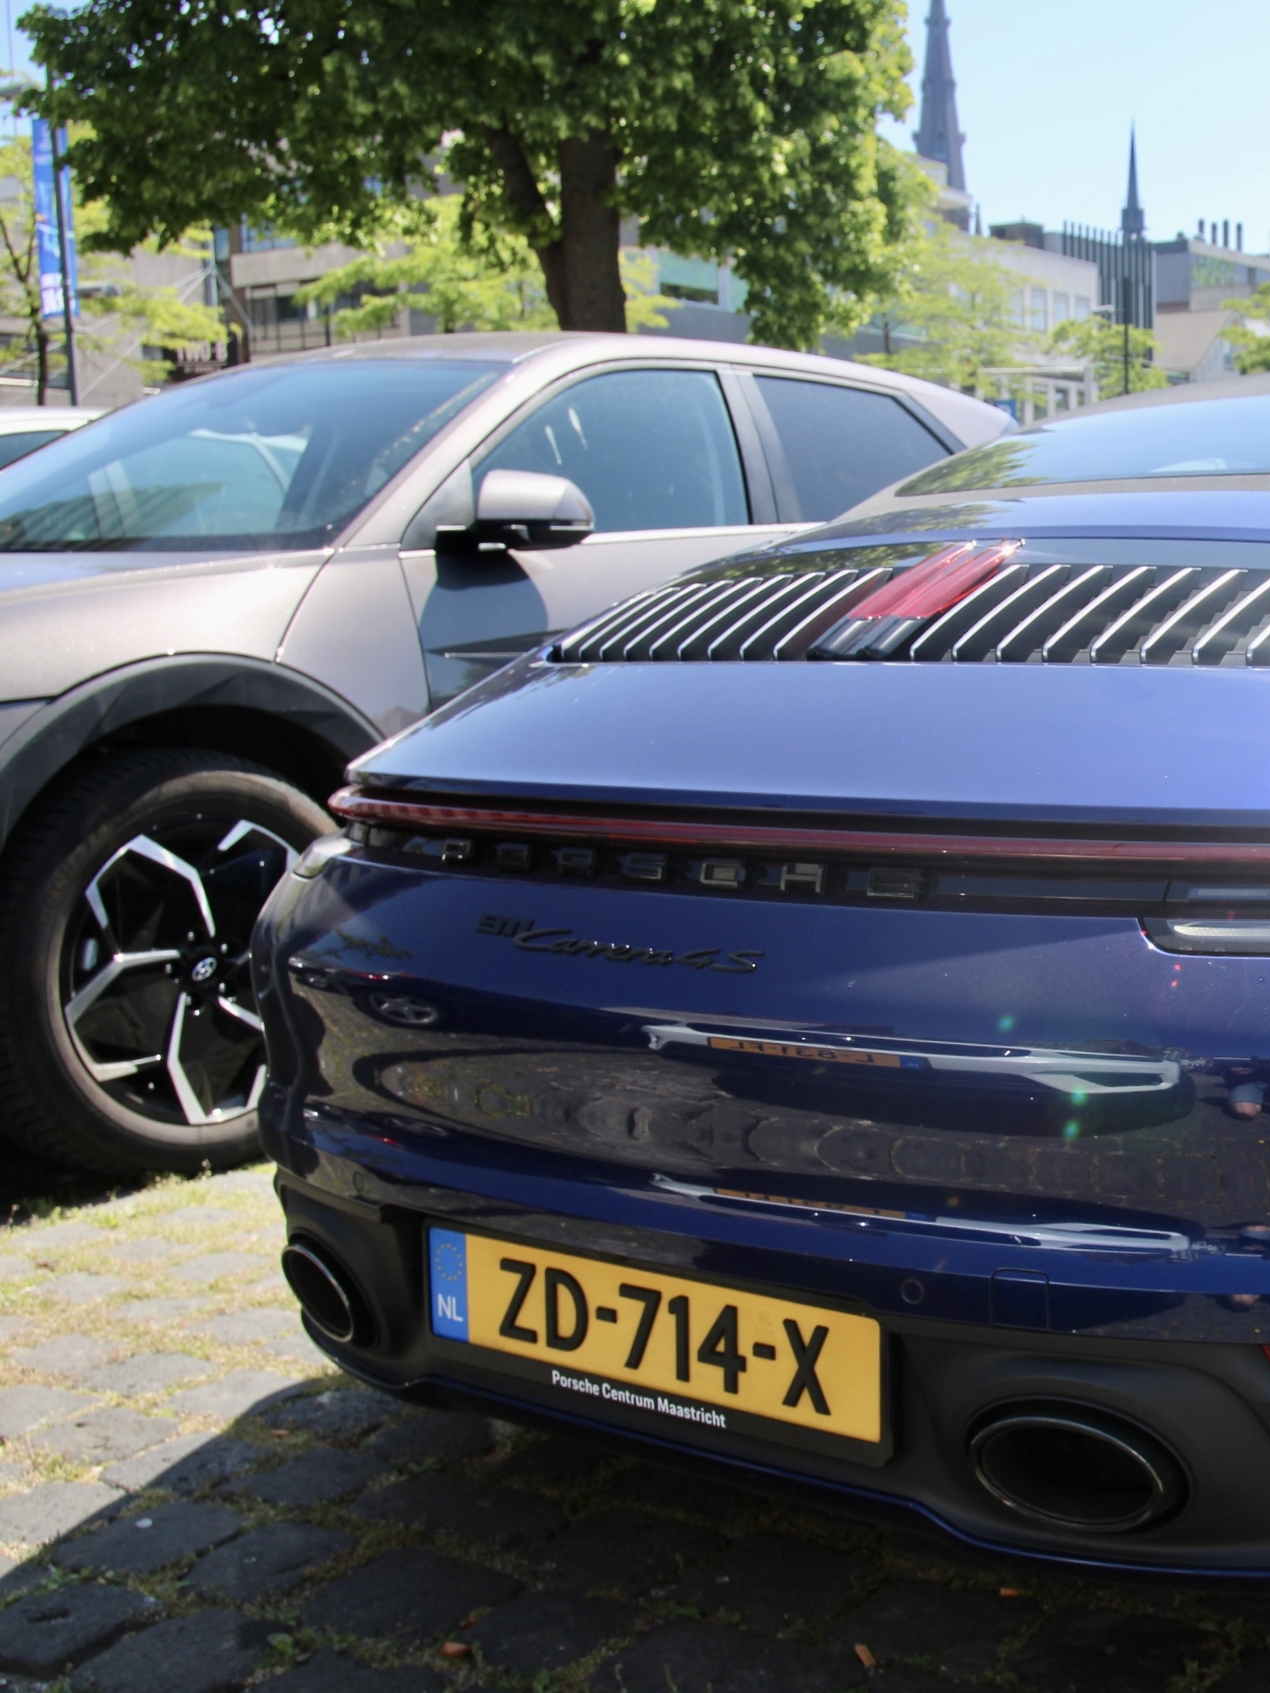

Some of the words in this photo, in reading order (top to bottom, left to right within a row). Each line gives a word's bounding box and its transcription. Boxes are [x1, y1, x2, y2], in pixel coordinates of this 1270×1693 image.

[441, 836, 920, 900] PORSCHE
[474, 913, 535, 937] 911
[437, 1293, 463, 1323] NL
[499, 1257, 832, 1416] ZD-714-X
[551, 1369, 600, 1396] Porsche
[601, 1382, 655, 1411] Centrum
[657, 1396, 726, 1429] Maastricht
